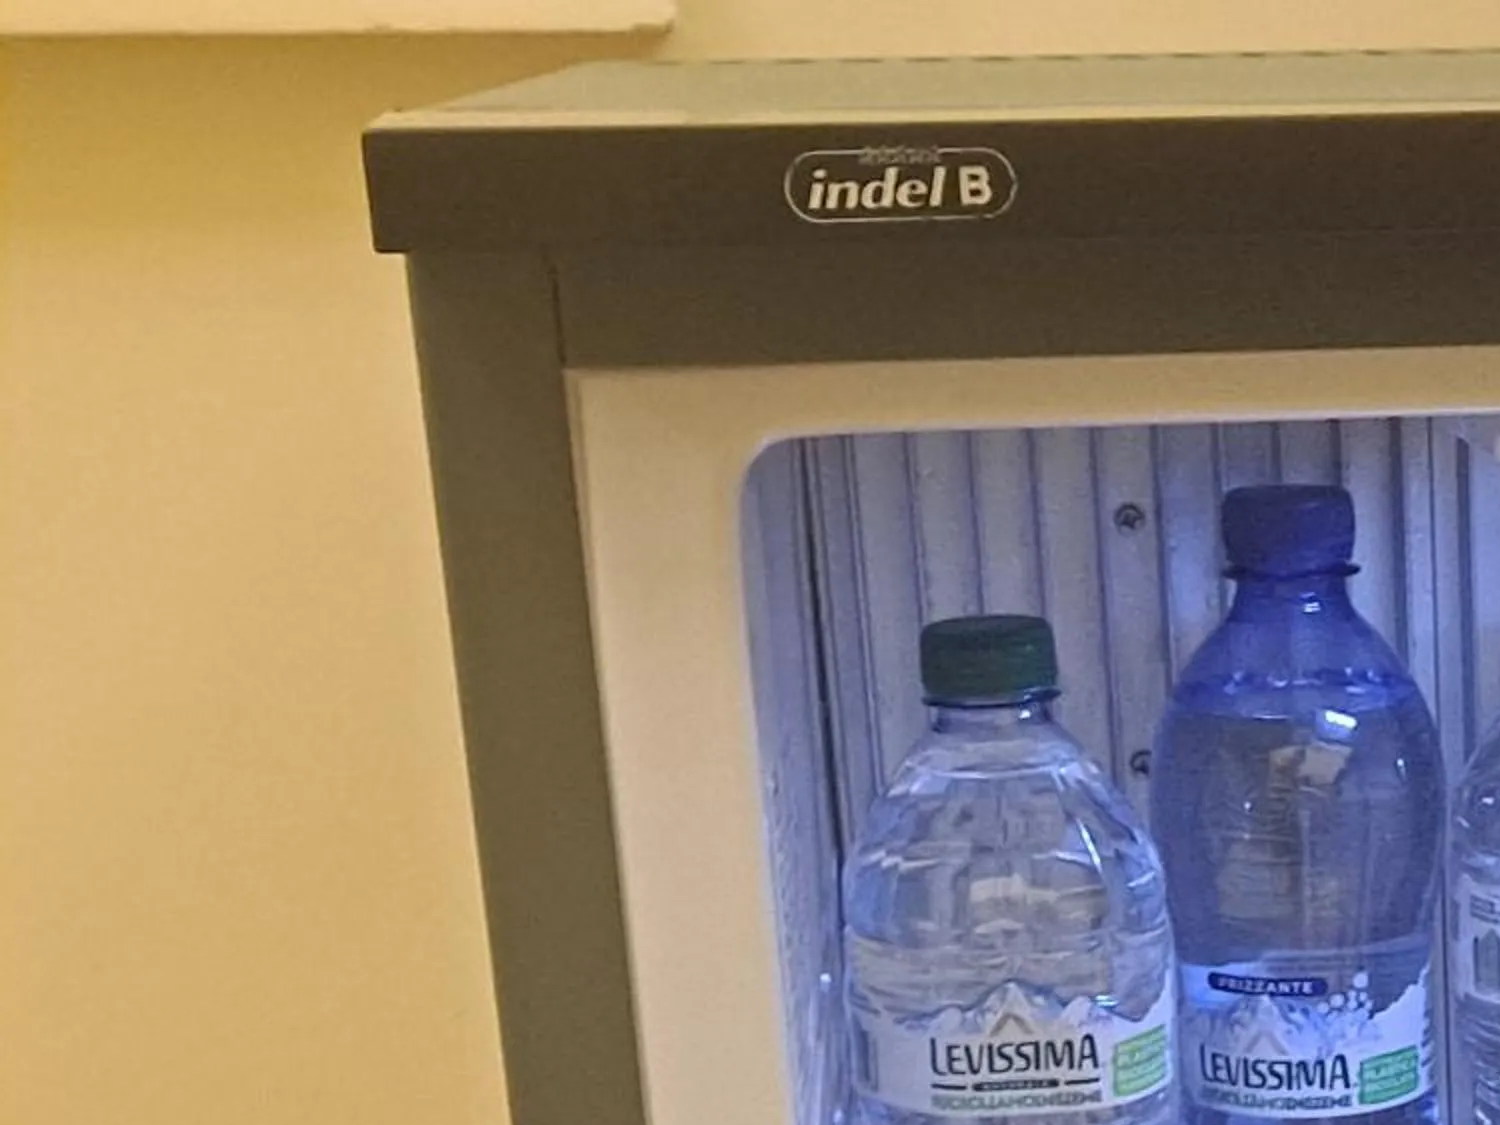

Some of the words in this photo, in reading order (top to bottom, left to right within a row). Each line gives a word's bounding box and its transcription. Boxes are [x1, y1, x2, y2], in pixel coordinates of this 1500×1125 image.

[808, 165, 946, 210] indel
[958, 164, 992, 206] B
[929, 1032, 1100, 1077] LEVISSIMA
[1199, 1042, 1352, 1091] LEVISSIMA
